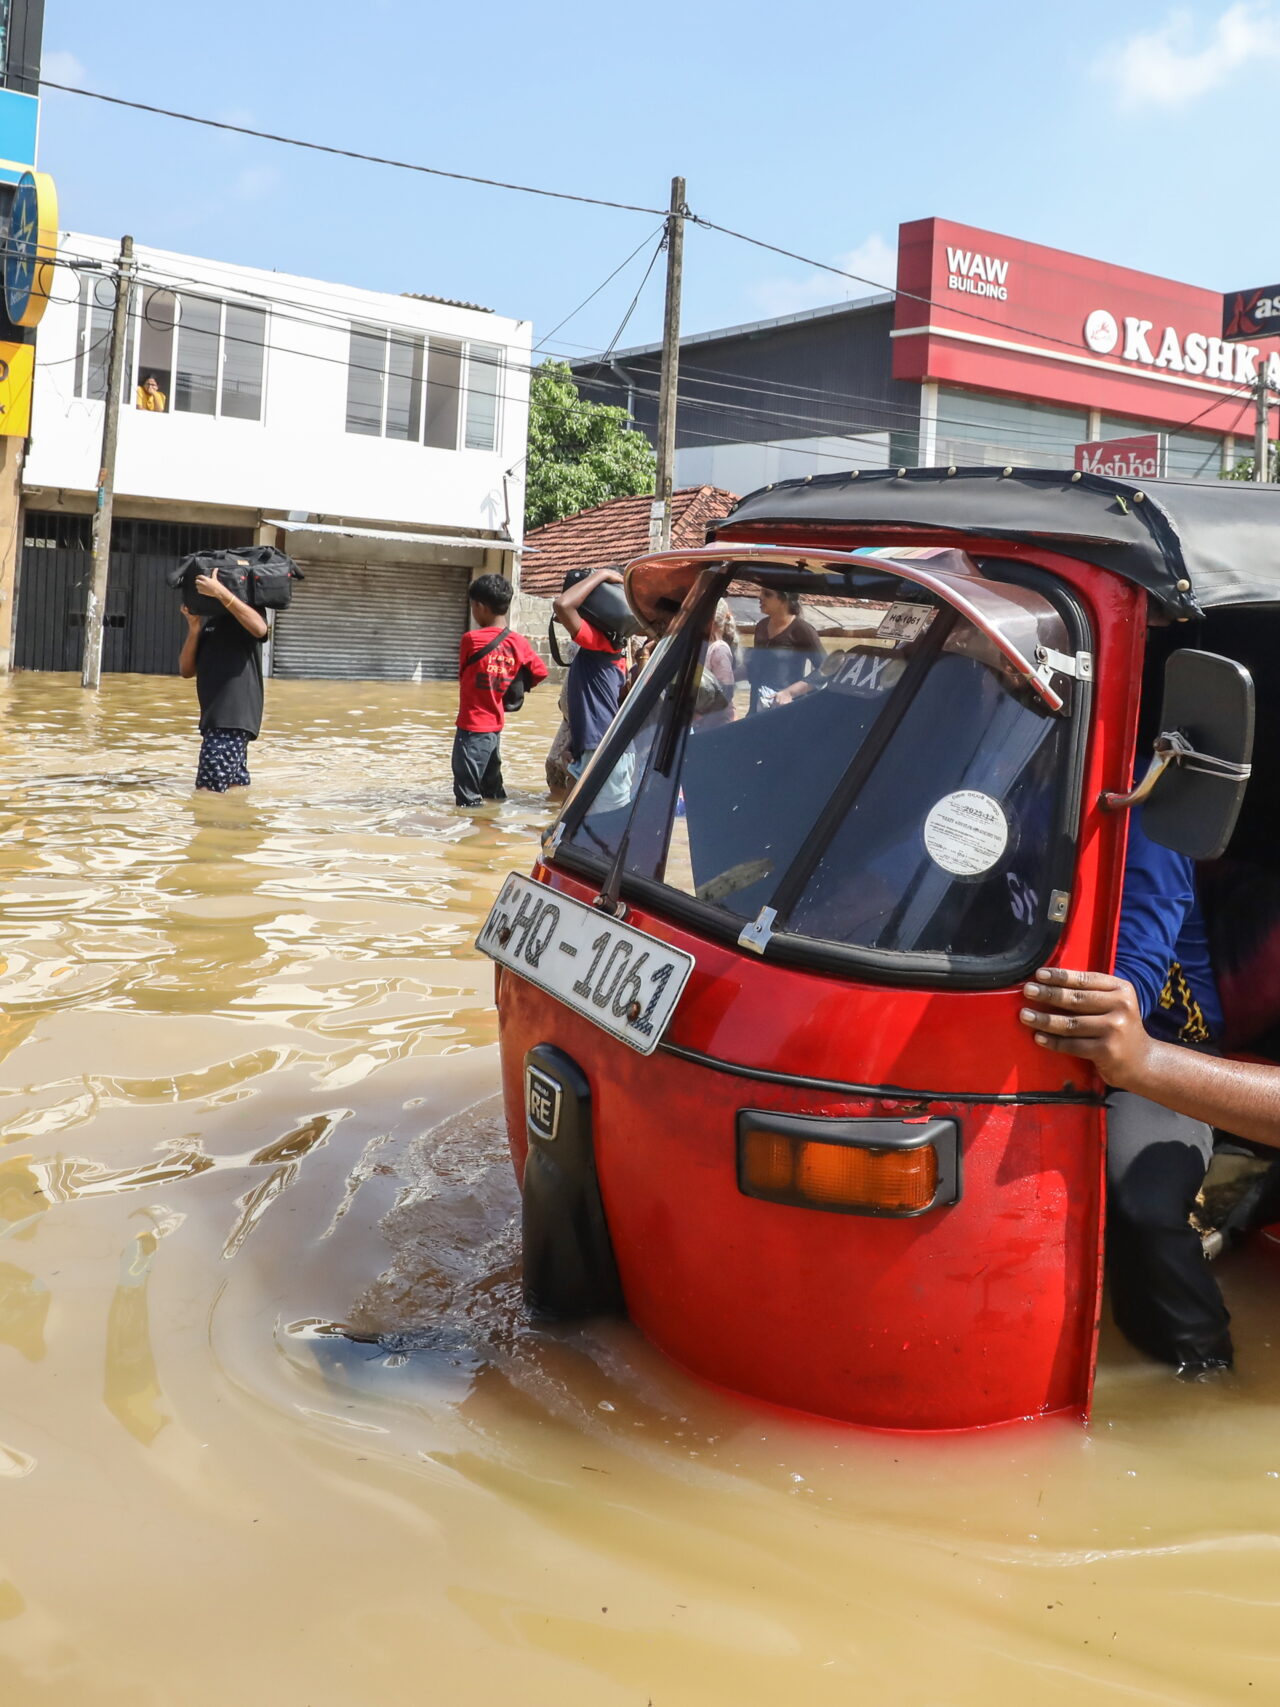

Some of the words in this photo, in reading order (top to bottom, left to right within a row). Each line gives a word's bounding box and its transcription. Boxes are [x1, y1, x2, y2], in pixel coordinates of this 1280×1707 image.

[946, 246, 1009, 285] WAW
[948, 274, 1008, 301] BUILDING
[889, 613, 922, 626] HQ-1061
[832, 653, 884, 692] TAX
[530, 1089, 552, 1127] RE
